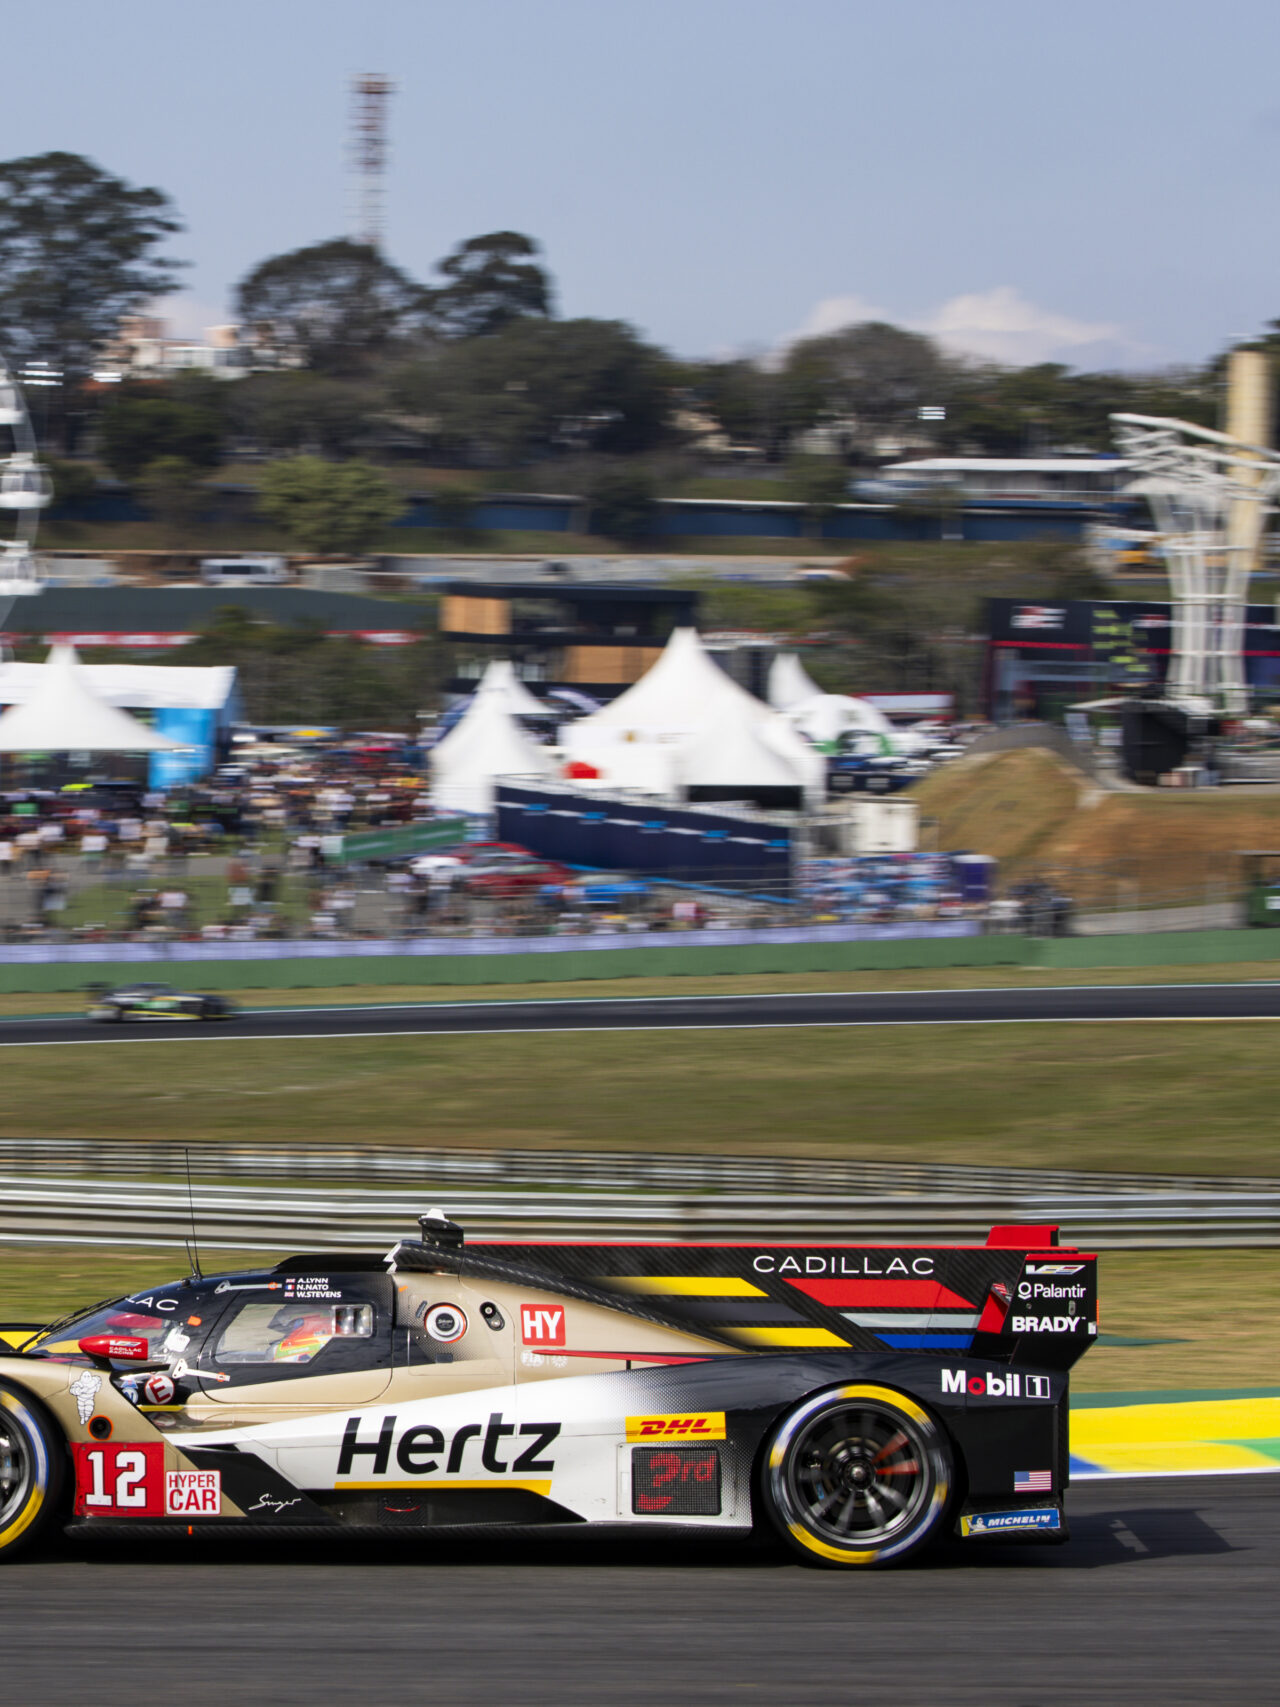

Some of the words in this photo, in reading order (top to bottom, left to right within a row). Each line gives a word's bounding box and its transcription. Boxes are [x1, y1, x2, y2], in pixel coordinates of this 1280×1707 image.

[753, 1255, 934, 1275] CADILLAC
[1034, 1284, 1086, 1298] Palantir
[523, 1310, 562, 1340] HY
[941, 1369, 1020, 1397] Mobil
[640, 1419, 711, 1436] DHL
[336, 1413, 562, 1475] Hertz
[86, 1450, 147, 1508] 12
[170, 1474, 216, 1488] HYPER
[170, 1489, 217, 1511] CAR
[987, 1515, 1051, 1527] MICHELIN
